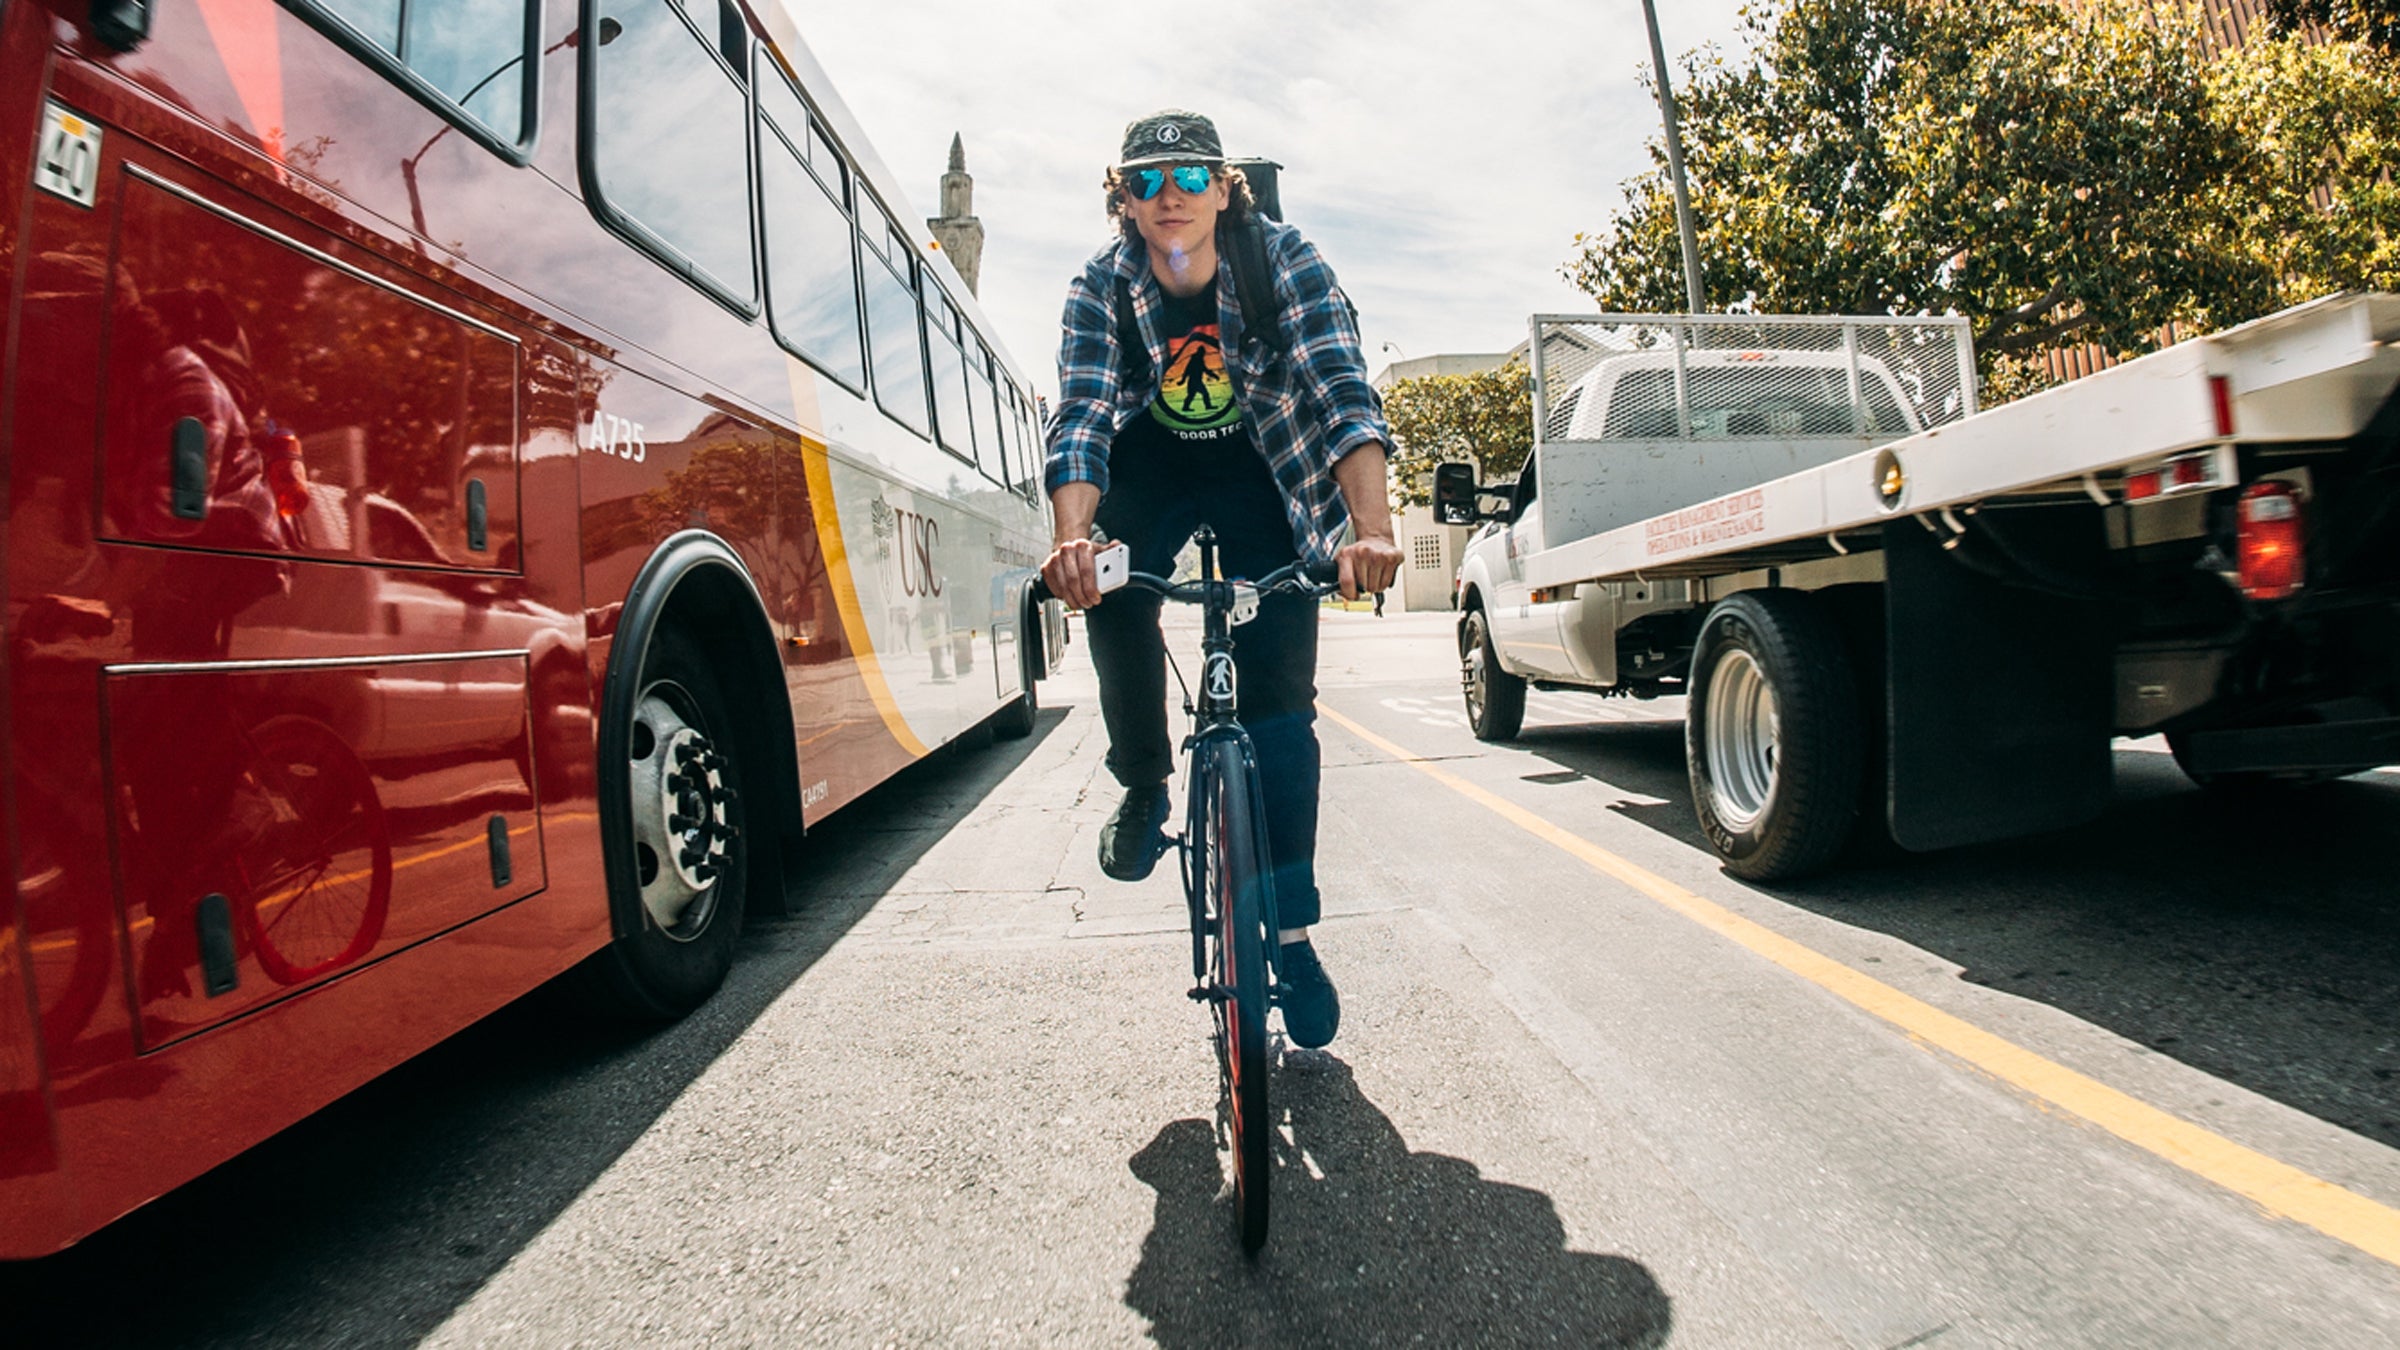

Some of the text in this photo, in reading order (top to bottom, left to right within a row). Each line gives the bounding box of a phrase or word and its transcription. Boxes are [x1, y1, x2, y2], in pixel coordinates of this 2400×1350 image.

[42, 130, 94, 197] 40
[590, 410, 646, 463] A735
[895, 508, 942, 598] USC
